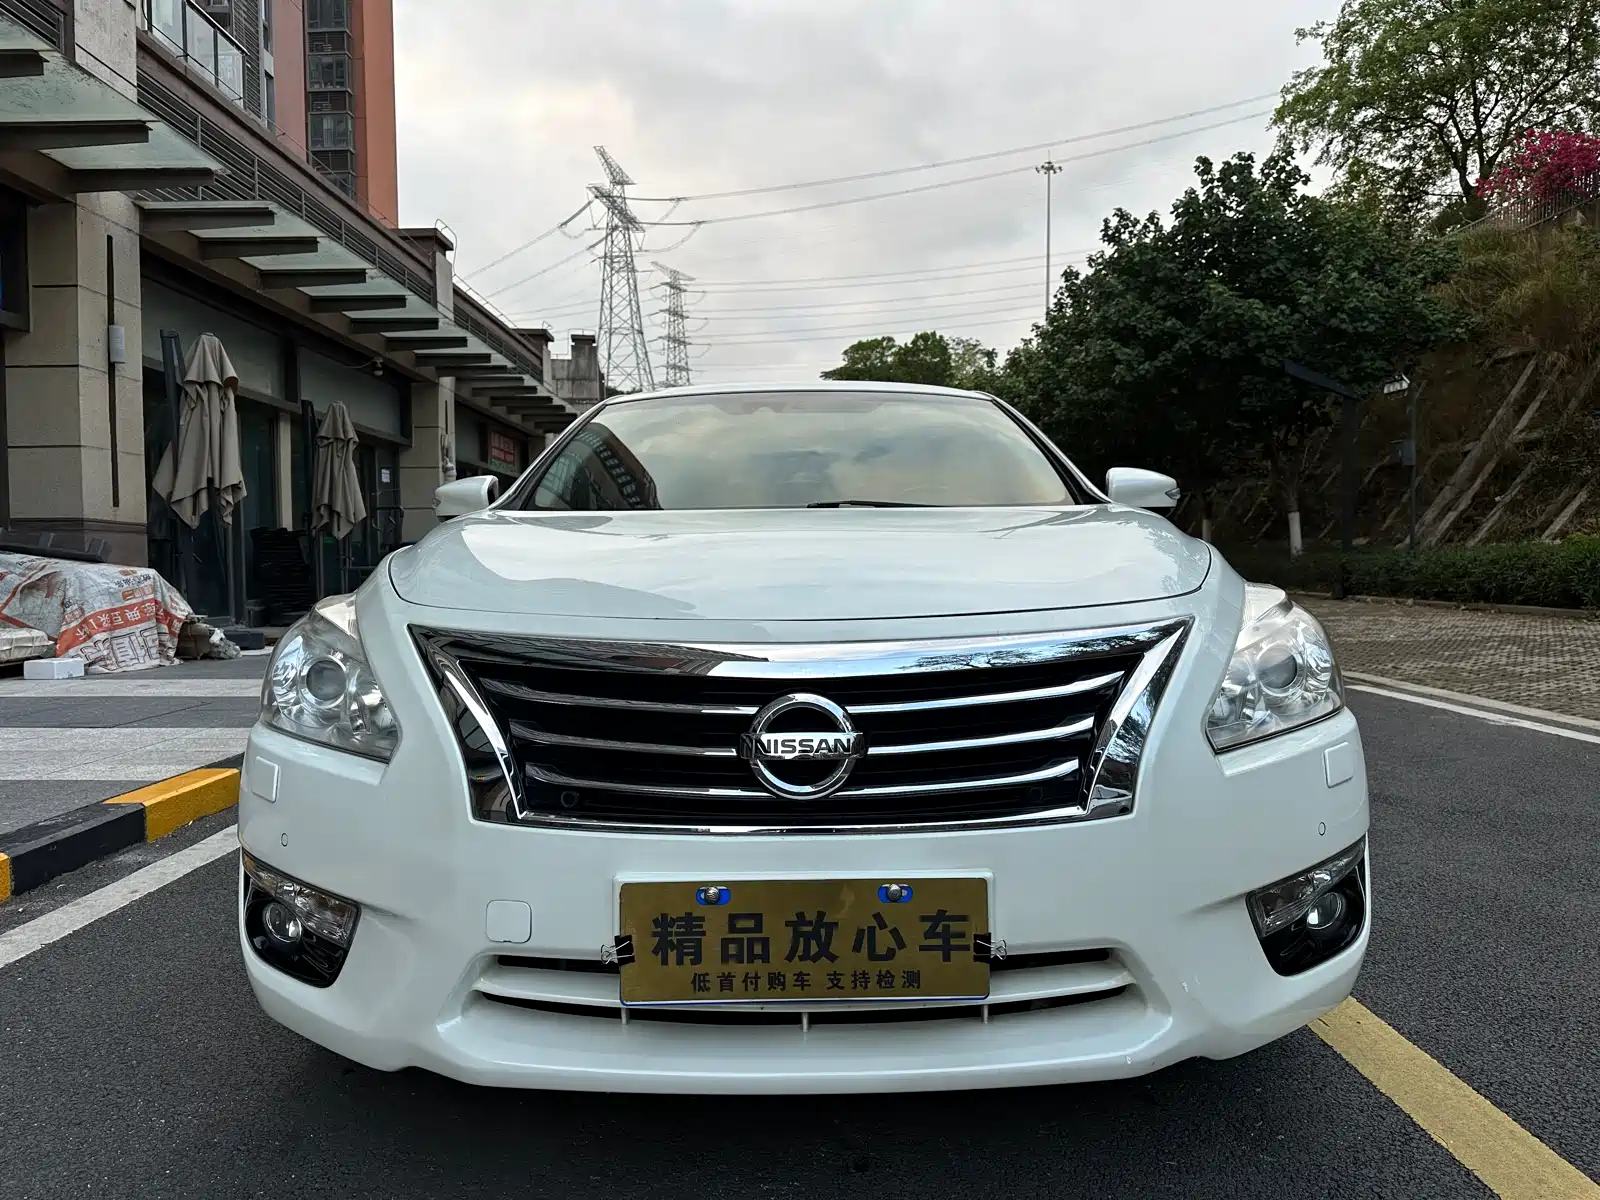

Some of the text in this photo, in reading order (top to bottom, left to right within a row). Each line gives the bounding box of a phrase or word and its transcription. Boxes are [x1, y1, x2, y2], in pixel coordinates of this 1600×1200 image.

[753, 738, 850, 755] NISSAN
[651, 910, 971, 966] 精品放心车
[690, 970, 921, 994] 低首付购车 支持检测
